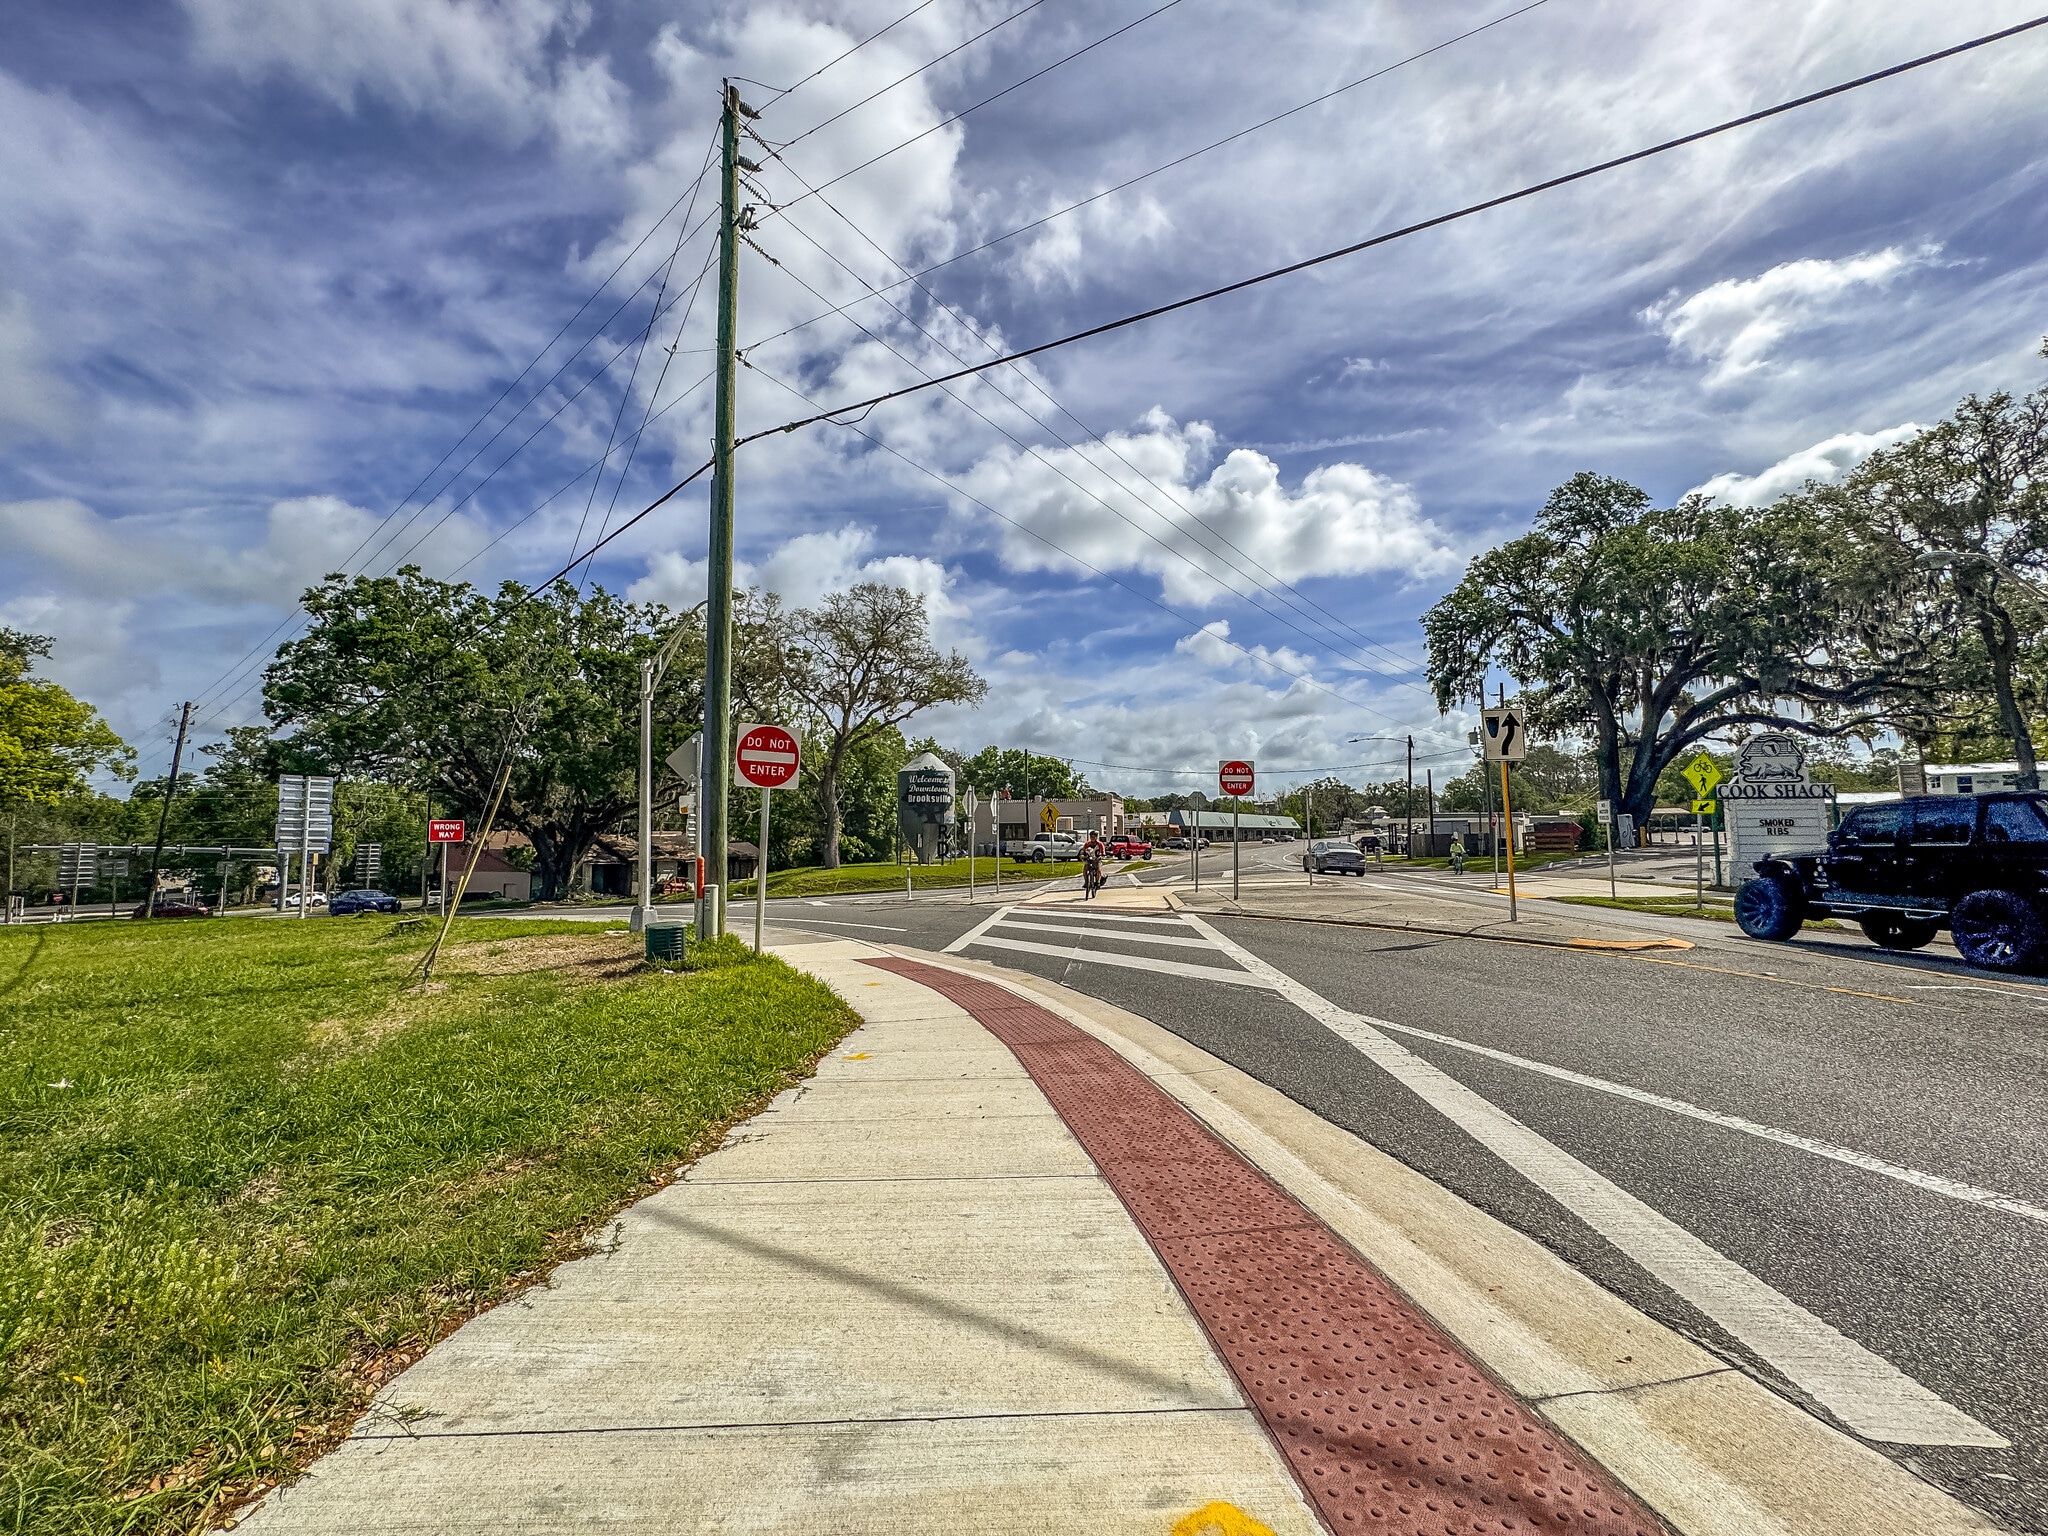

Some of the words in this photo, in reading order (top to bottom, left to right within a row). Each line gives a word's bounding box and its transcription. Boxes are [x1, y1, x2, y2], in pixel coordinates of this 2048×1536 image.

[747, 736, 763, 748] DO
[769, 738, 791, 750] NOT
[749, 764, 785, 776] ENTER
[909, 774, 943, 783] Welcome
[908, 783, 950, 793] Downtown
[1227, 782, 1247, 790] ENTER
[1717, 784, 1768, 798] COOK
[1774, 784, 1835, 798] SHACK
[908, 794, 951, 803] Brooksville
[433, 823, 460, 831] WRONG
[1759, 819, 1795, 827] SMOKED
[438, 831, 455, 839] WAY
[1766, 827, 1790, 836] RIBS
